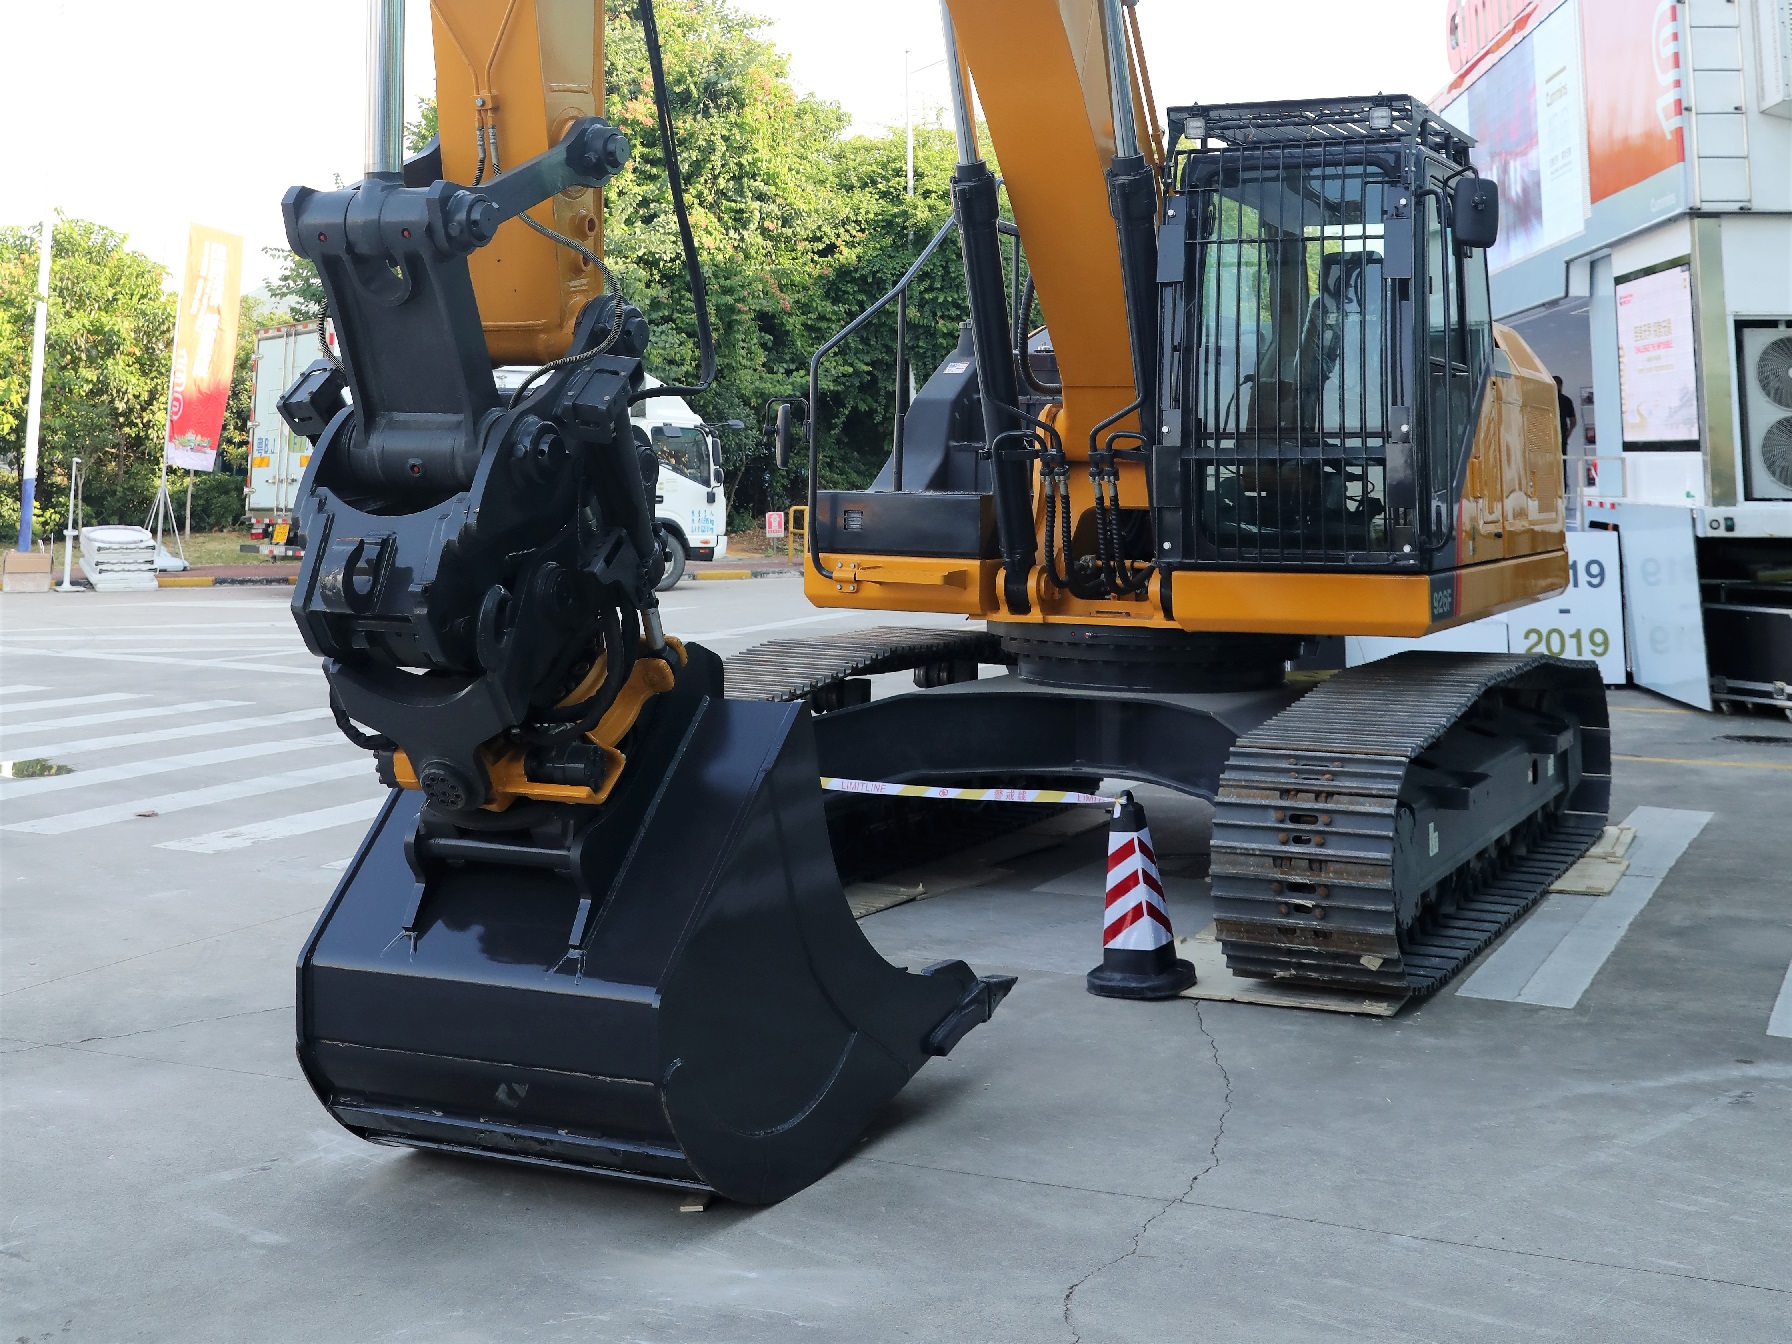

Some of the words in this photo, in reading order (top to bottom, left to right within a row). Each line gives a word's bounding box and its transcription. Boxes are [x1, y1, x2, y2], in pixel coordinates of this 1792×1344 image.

[1433, 588, 1452, 615] 926F
[1523, 627, 1610, 657] 2019
[841, 780, 887, 794] LIMITLINE
[994, 788, 1027, 801] 警戒线
